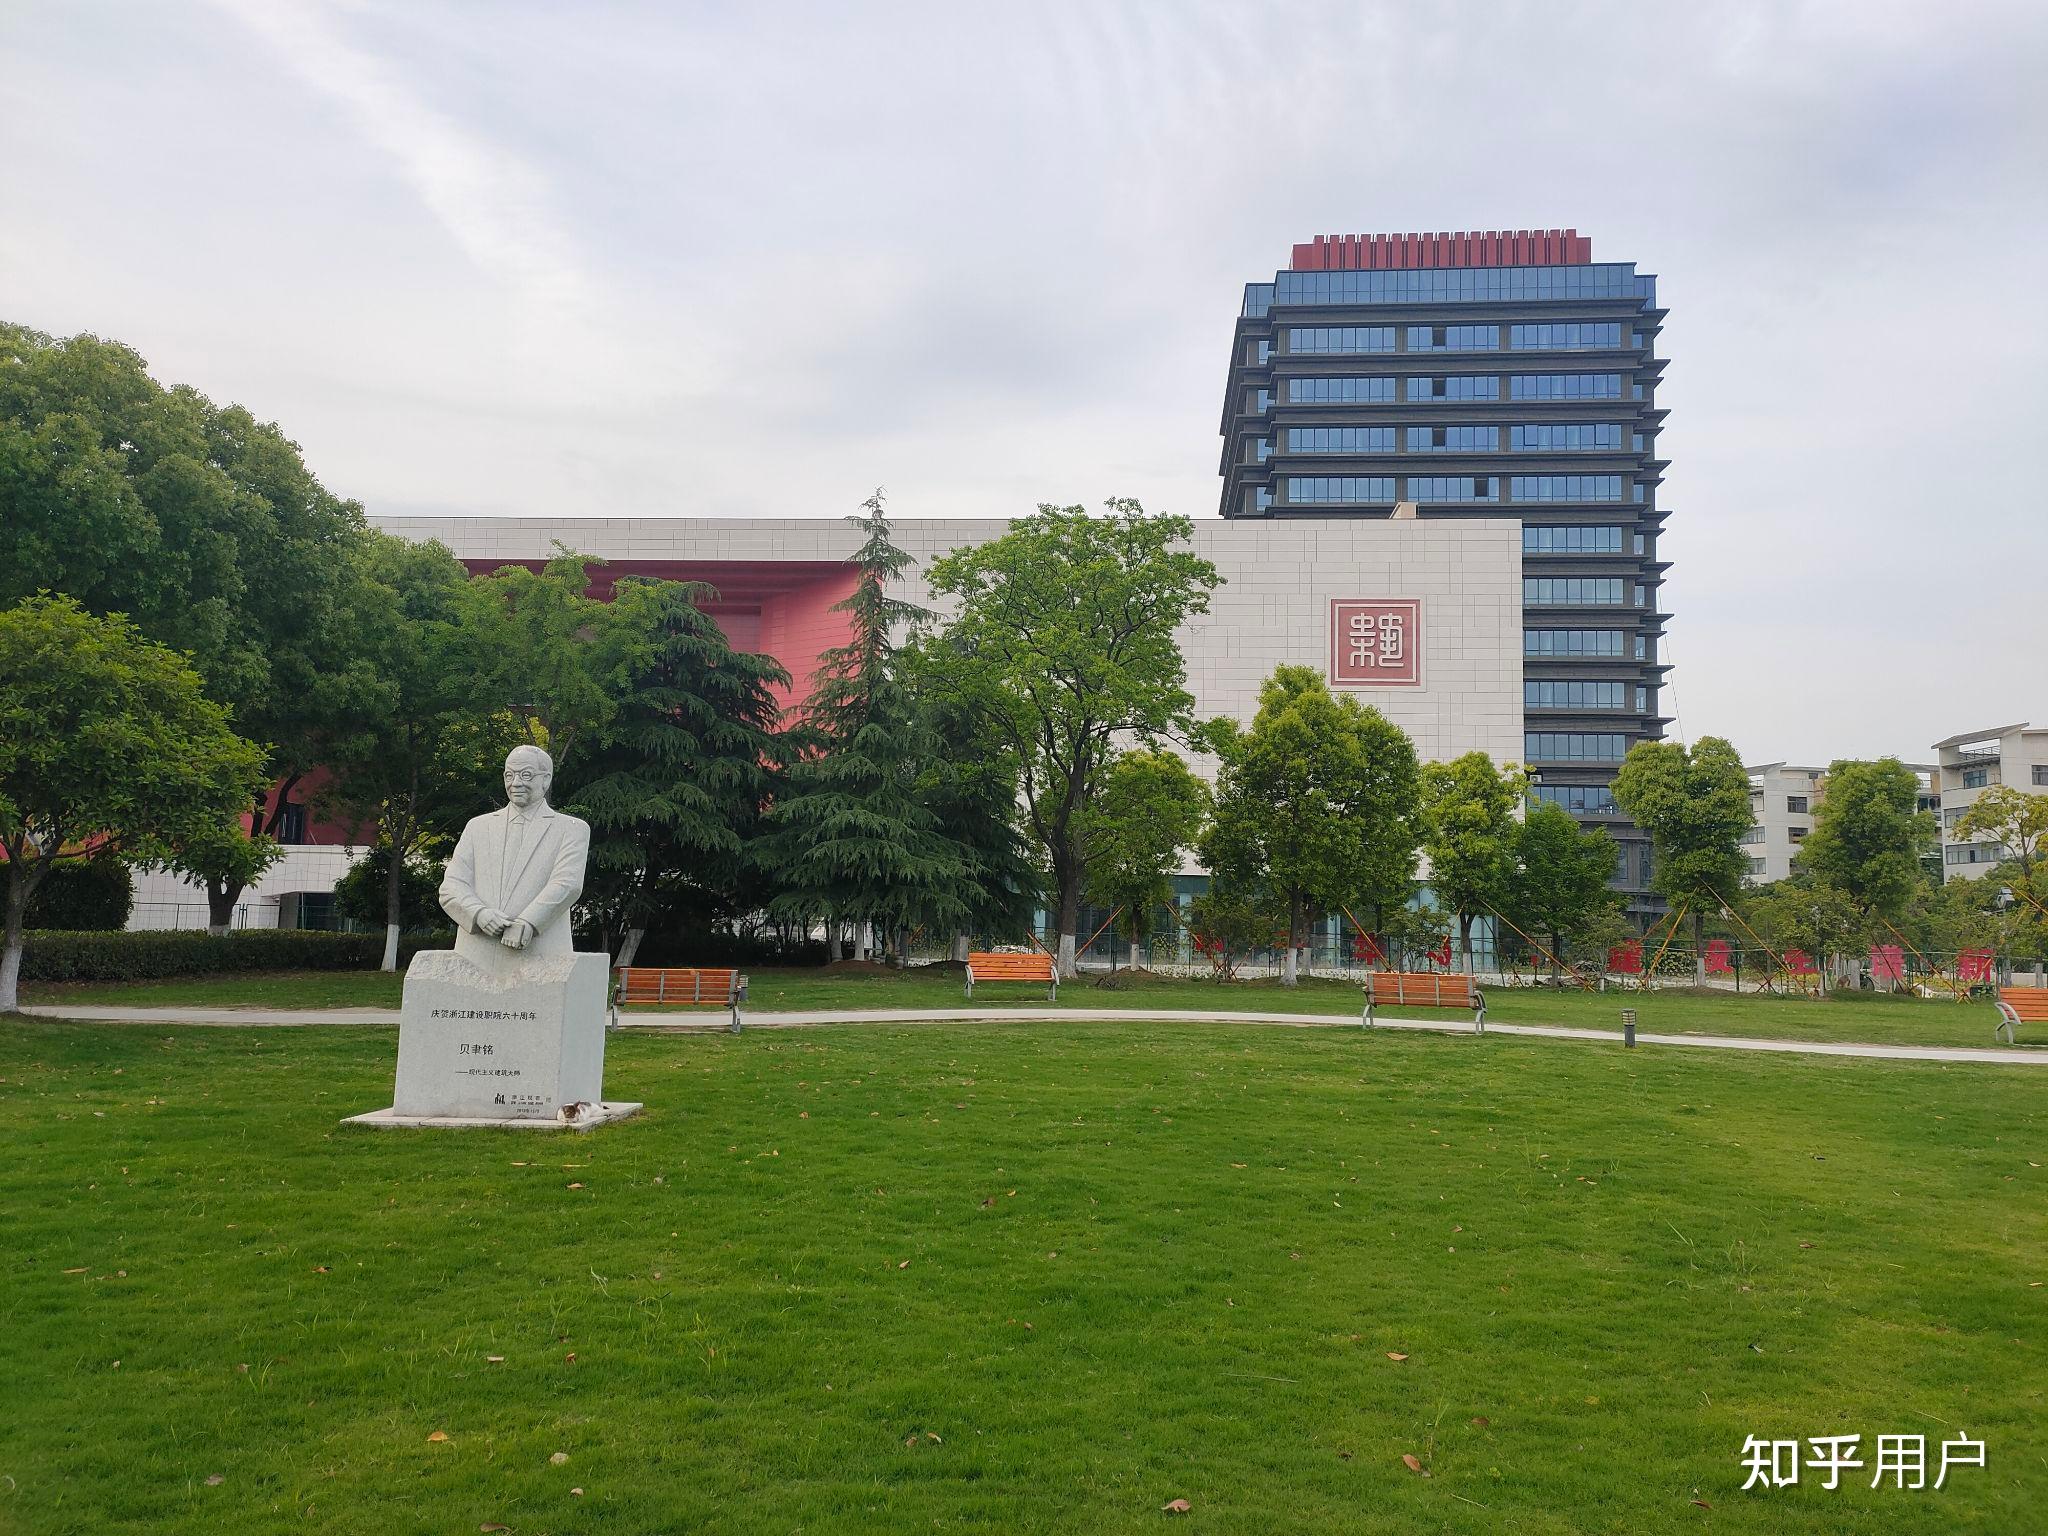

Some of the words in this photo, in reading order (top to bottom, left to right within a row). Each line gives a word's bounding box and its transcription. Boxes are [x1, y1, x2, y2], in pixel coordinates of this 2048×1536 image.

[430, 1009, 537, 1021] 庆贺浙江建设职院六十周年
[459, 1043, 494, 1056] 贝聿铭
